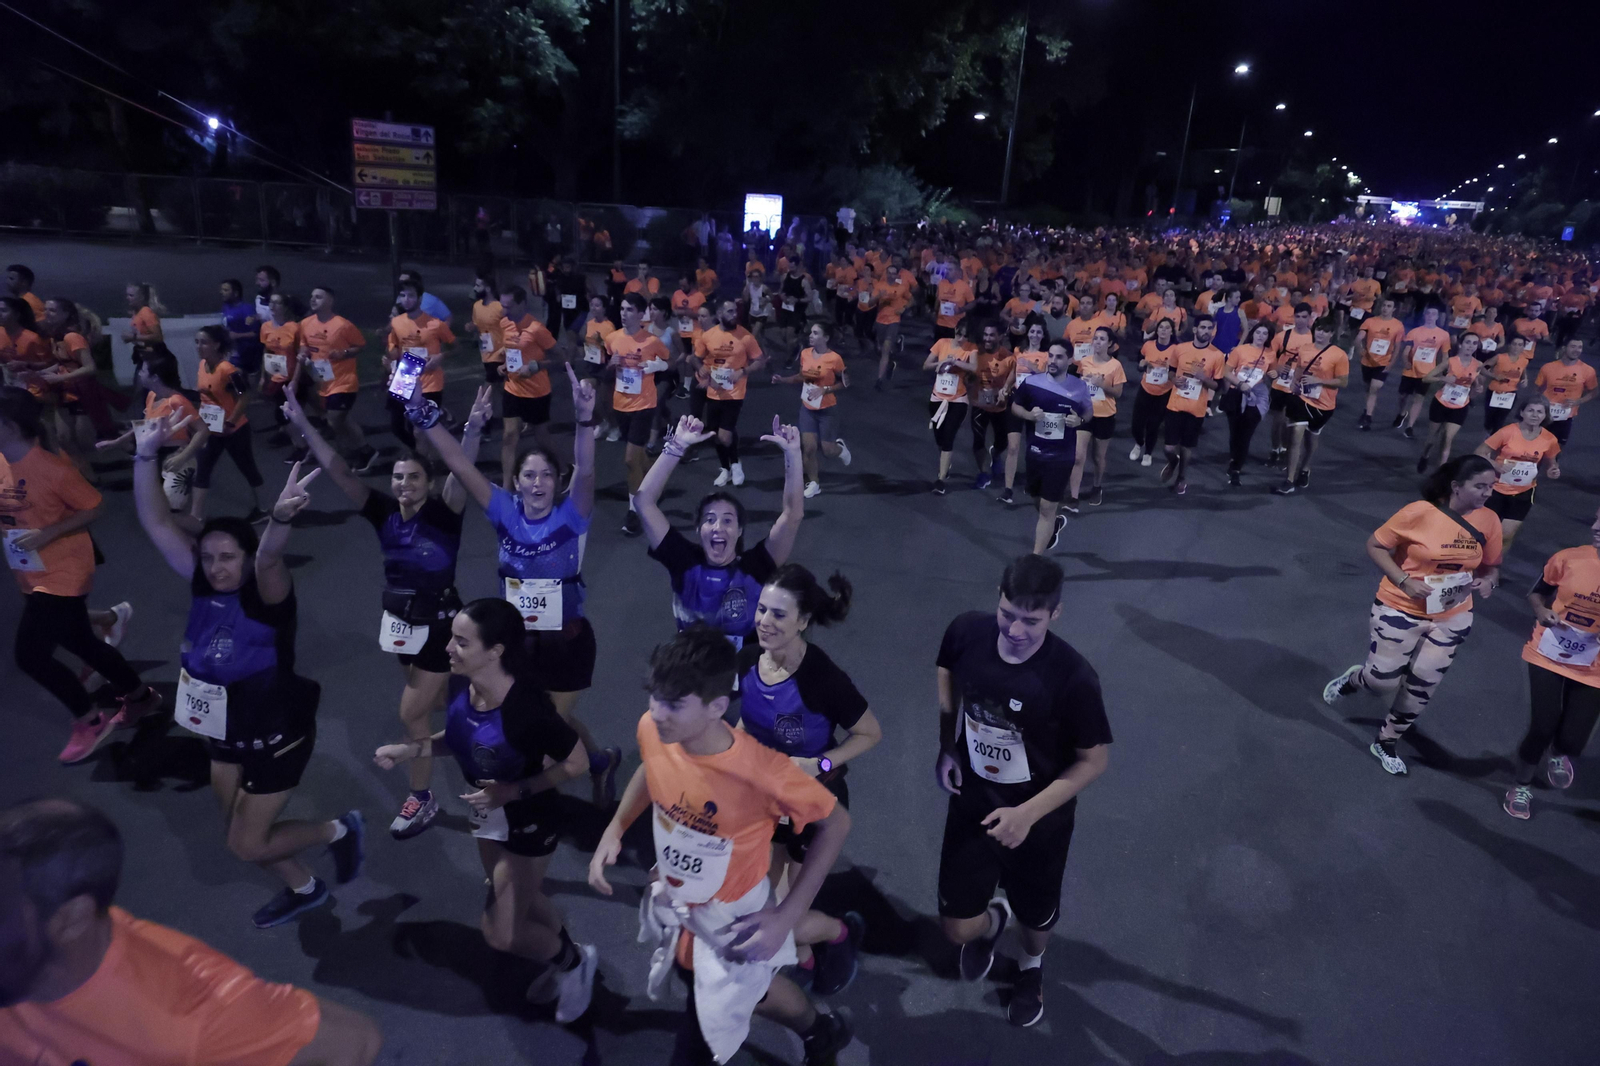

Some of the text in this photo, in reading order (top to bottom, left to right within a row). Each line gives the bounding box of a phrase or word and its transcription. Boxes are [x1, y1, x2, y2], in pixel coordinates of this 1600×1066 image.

[519, 596, 547, 609] 3394
[391, 621, 412, 635] 6971
[1558, 636, 1586, 652] 7395
[186, 694, 210, 714] 7693
[974, 739, 1011, 761] 20270
[663, 845, 702, 874] 4358
